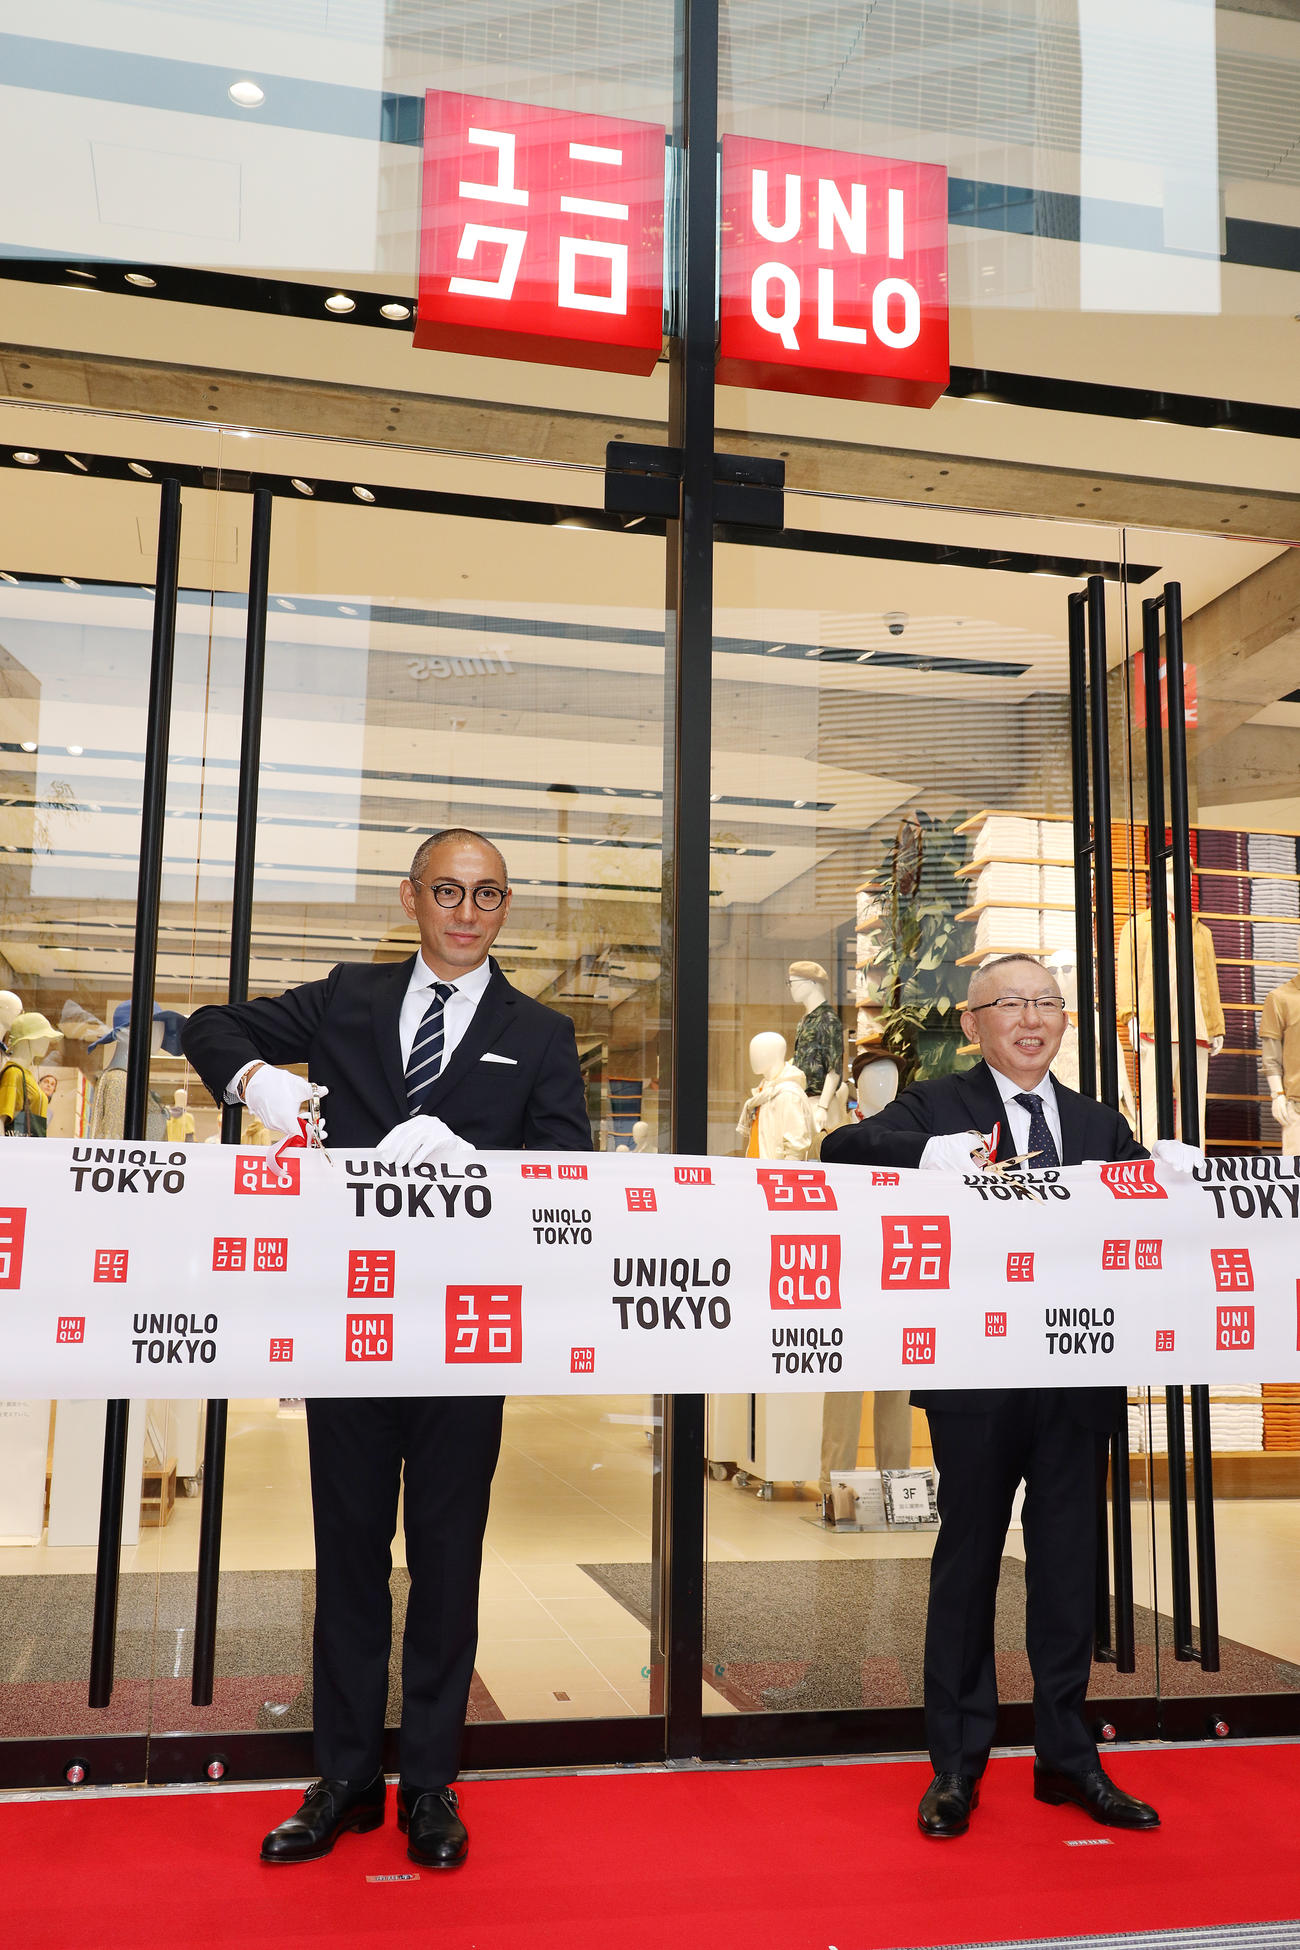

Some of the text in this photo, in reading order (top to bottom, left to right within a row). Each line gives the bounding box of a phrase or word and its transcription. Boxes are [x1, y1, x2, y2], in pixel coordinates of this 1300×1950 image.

[459, 127, 629, 220] ユニ
[751, 168, 904, 260] UNI
[448, 222, 628, 315] クロ
[751, 261, 921, 351] QLO
[73, 1147, 186, 1166] UNIQLO
[345, 1160, 488, 1181] UNIQLO
[562, 1167, 582, 1177] UNI
[678, 1169, 705, 1183] UNI
[1107, 1165, 1145, 1183] UNI
[70, 1167, 184, 1193] TOKYO
[243, 1173, 292, 1191] QLO
[1114, 1183, 1158, 1196] QLO
[346, 1183, 492, 1218] TOKYO
[533, 1209, 591, 1225] UNIQLO
[533, 1228, 591, 1244] TOKYO
[258, 1242, 281, 1253] UNI
[1139, 1243, 1157, 1253] UNI
[258, 1256, 283, 1269] QLO
[780, 1245, 827, 1269] UNI
[1138, 1255, 1158, 1268] QLO
[614, 1258, 730, 1292] UNIQLO
[778, 1276, 830, 1304] QLO
[613, 1297, 730, 1329] TOKYO
[988, 1315, 1002, 1323] UNI
[1046, 1308, 1114, 1330] UNIQLO
[1221, 1312, 1247, 1326] UNI
[61, 1320, 80, 1329] UNI
[134, 1314, 217, 1337] UNIQLO
[352, 1320, 384, 1335] UNI
[988, 1325, 1004, 1335] QLO
[60, 1331, 81, 1341] QLO
[773, 1328, 842, 1349] UNIQLO
[907, 1332, 929, 1345] UNI
[1046, 1332, 1114, 1354] TOKYO
[1221, 1330, 1250, 1347] QLO
[132, 1340, 216, 1363] TOKYO
[352, 1339, 387, 1358] QLO
[906, 1348, 931, 1362] QLO
[772, 1352, 842, 1373] TOKYO
[903, 1488, 917, 1500] 3F
